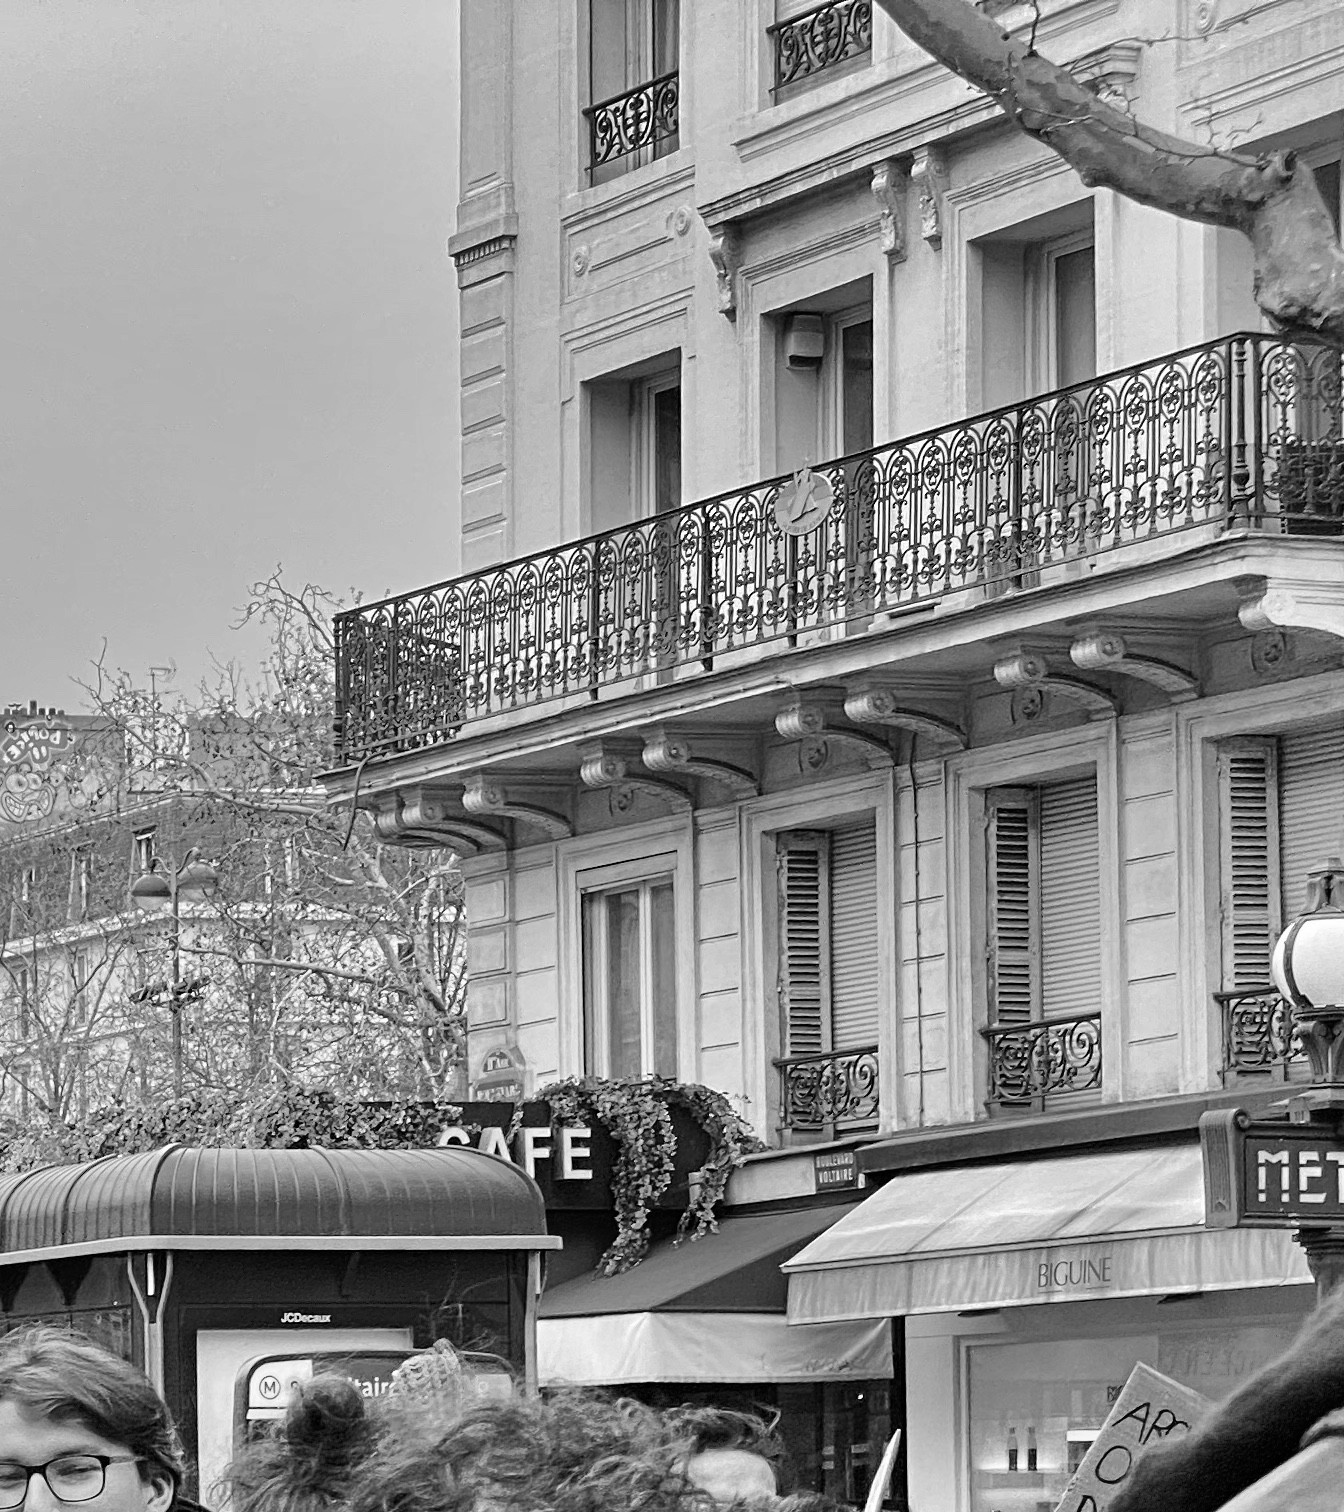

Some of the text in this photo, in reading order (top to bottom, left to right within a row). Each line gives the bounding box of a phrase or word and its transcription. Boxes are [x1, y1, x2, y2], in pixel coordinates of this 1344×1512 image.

[819, 1169, 853, 1183] VOLTAIRE
[1038, 1257, 1112, 1288] BIGUINE
[281, 1312, 331, 1323] JCDecaux
